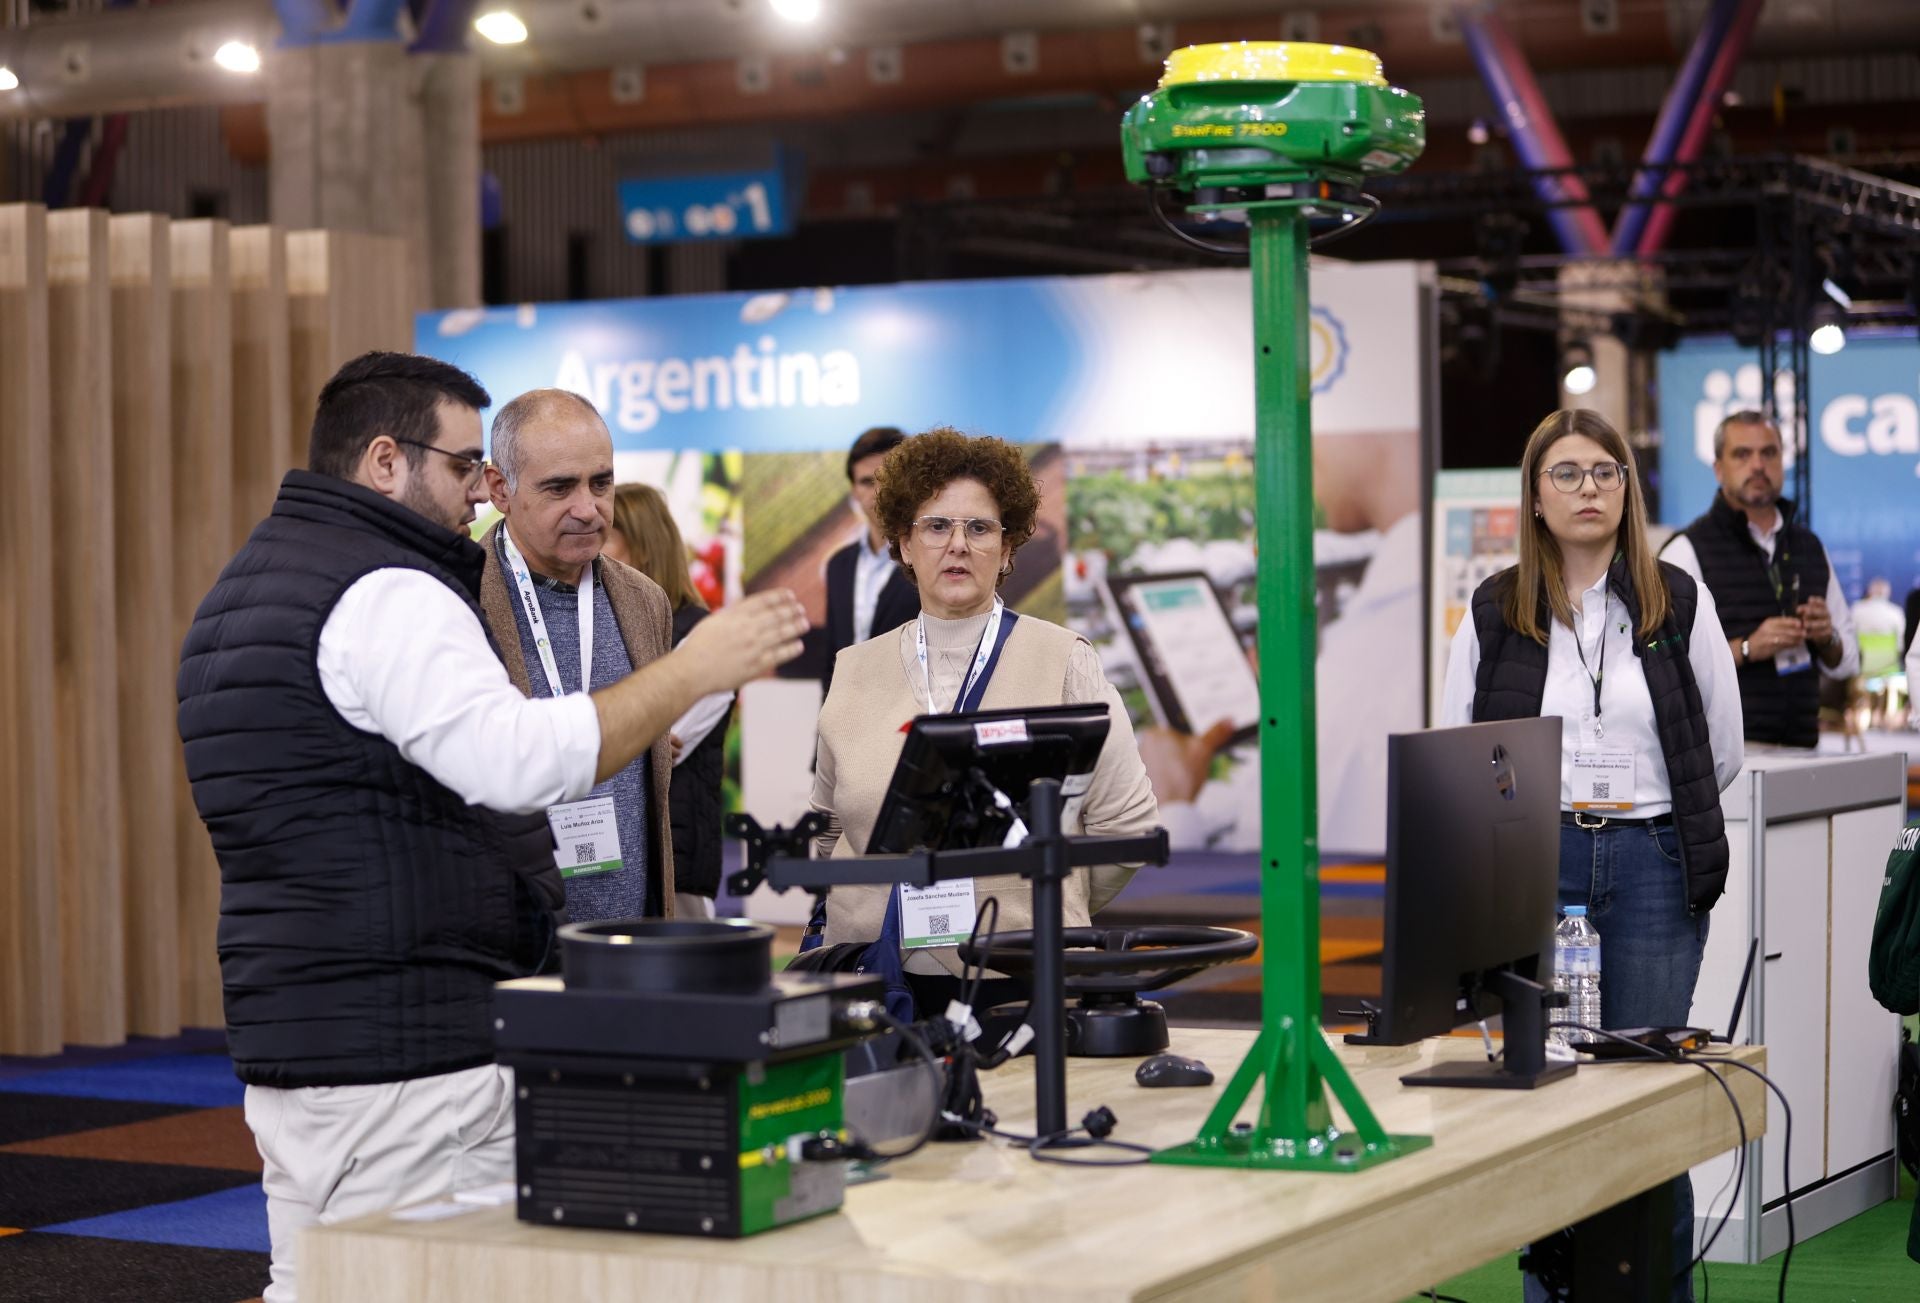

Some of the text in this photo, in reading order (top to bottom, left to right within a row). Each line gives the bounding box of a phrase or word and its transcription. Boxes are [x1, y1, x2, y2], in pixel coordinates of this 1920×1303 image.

[1239, 122, 1288, 138] 7500
[554, 337, 860, 433] Argentina
[1820, 378, 1920, 470] ca
[523, 590, 540, 625] AgroBank
[573, 820, 590, 828] Muñoz
[907, 893, 924, 901] Josefa
[925, 892, 946, 900] Sánchez
